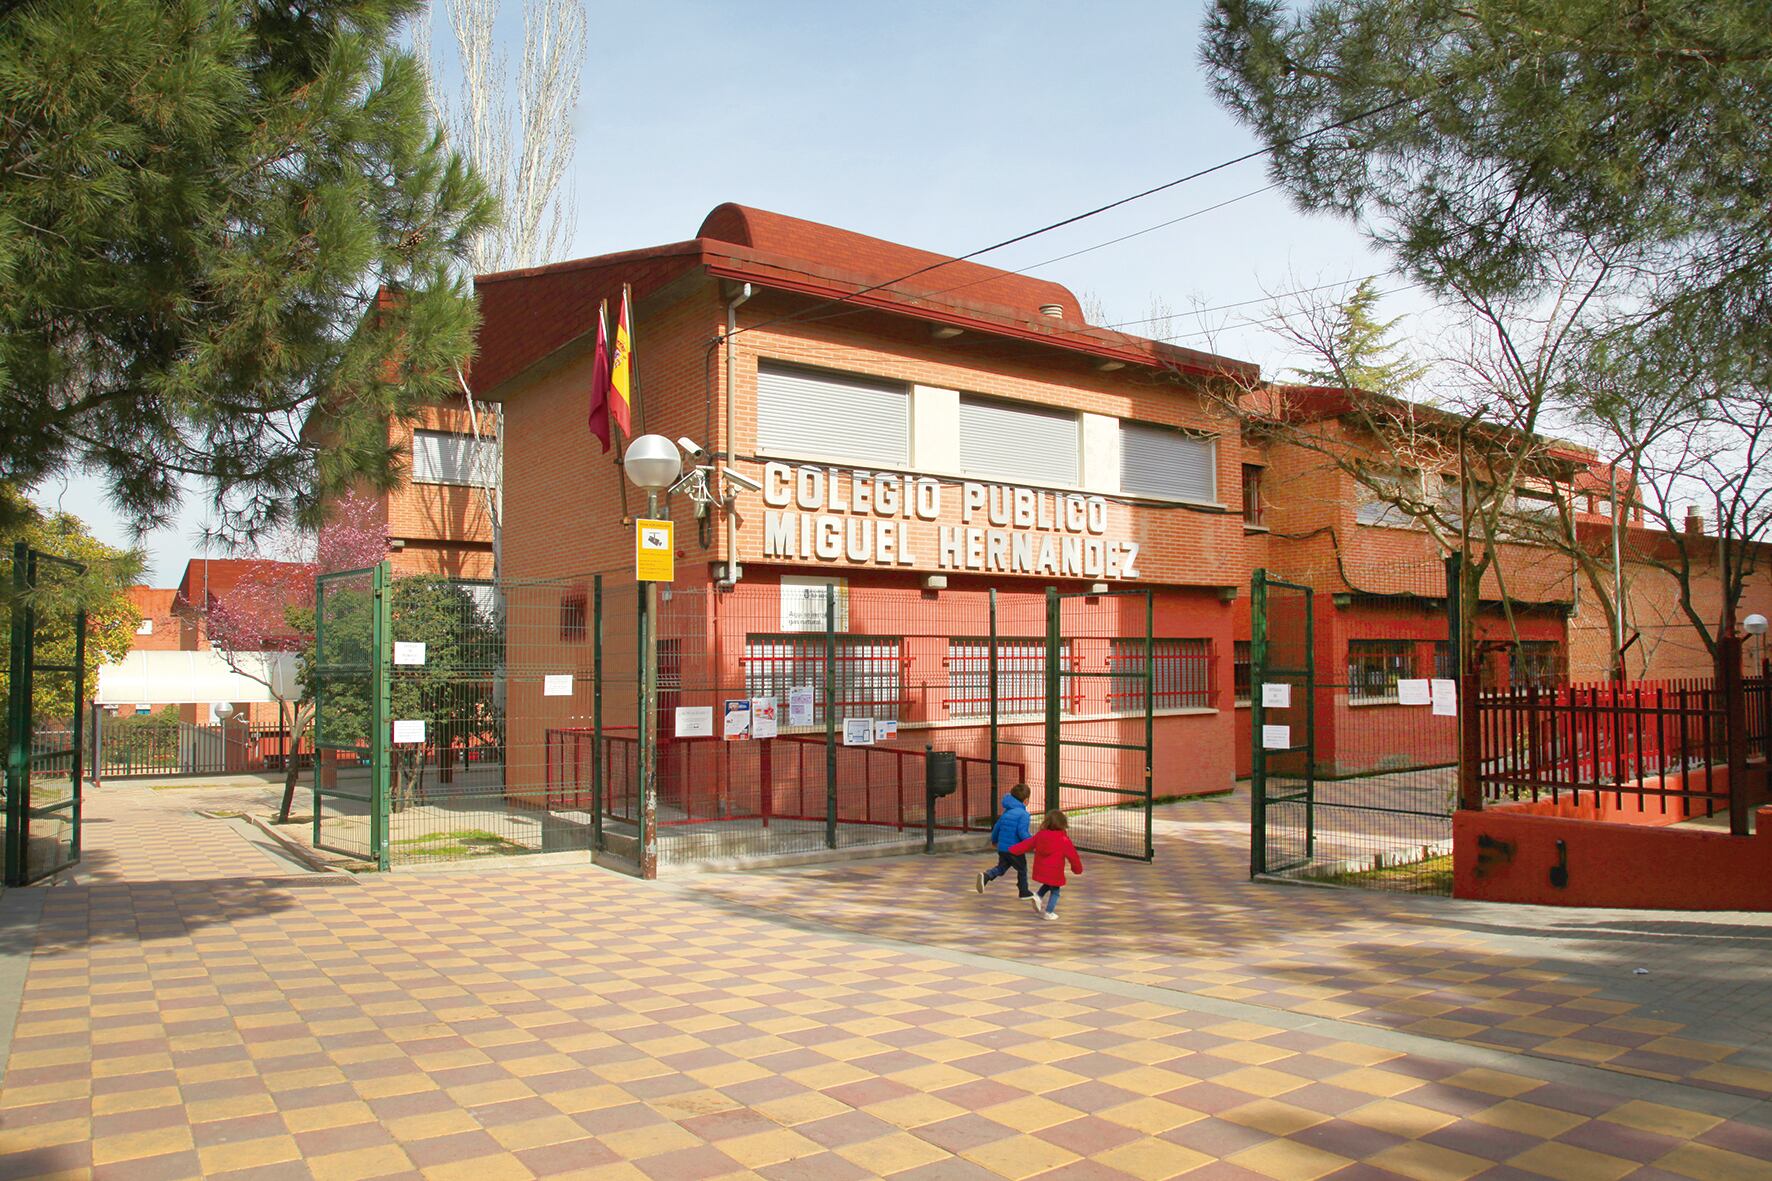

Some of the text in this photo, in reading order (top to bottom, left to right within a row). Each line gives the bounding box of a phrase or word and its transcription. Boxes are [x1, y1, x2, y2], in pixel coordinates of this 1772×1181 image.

[763, 461, 1107, 534] COLEGIO PUBLICO
[763, 511, 1140, 578] MIGUEL HERNANDEZ
